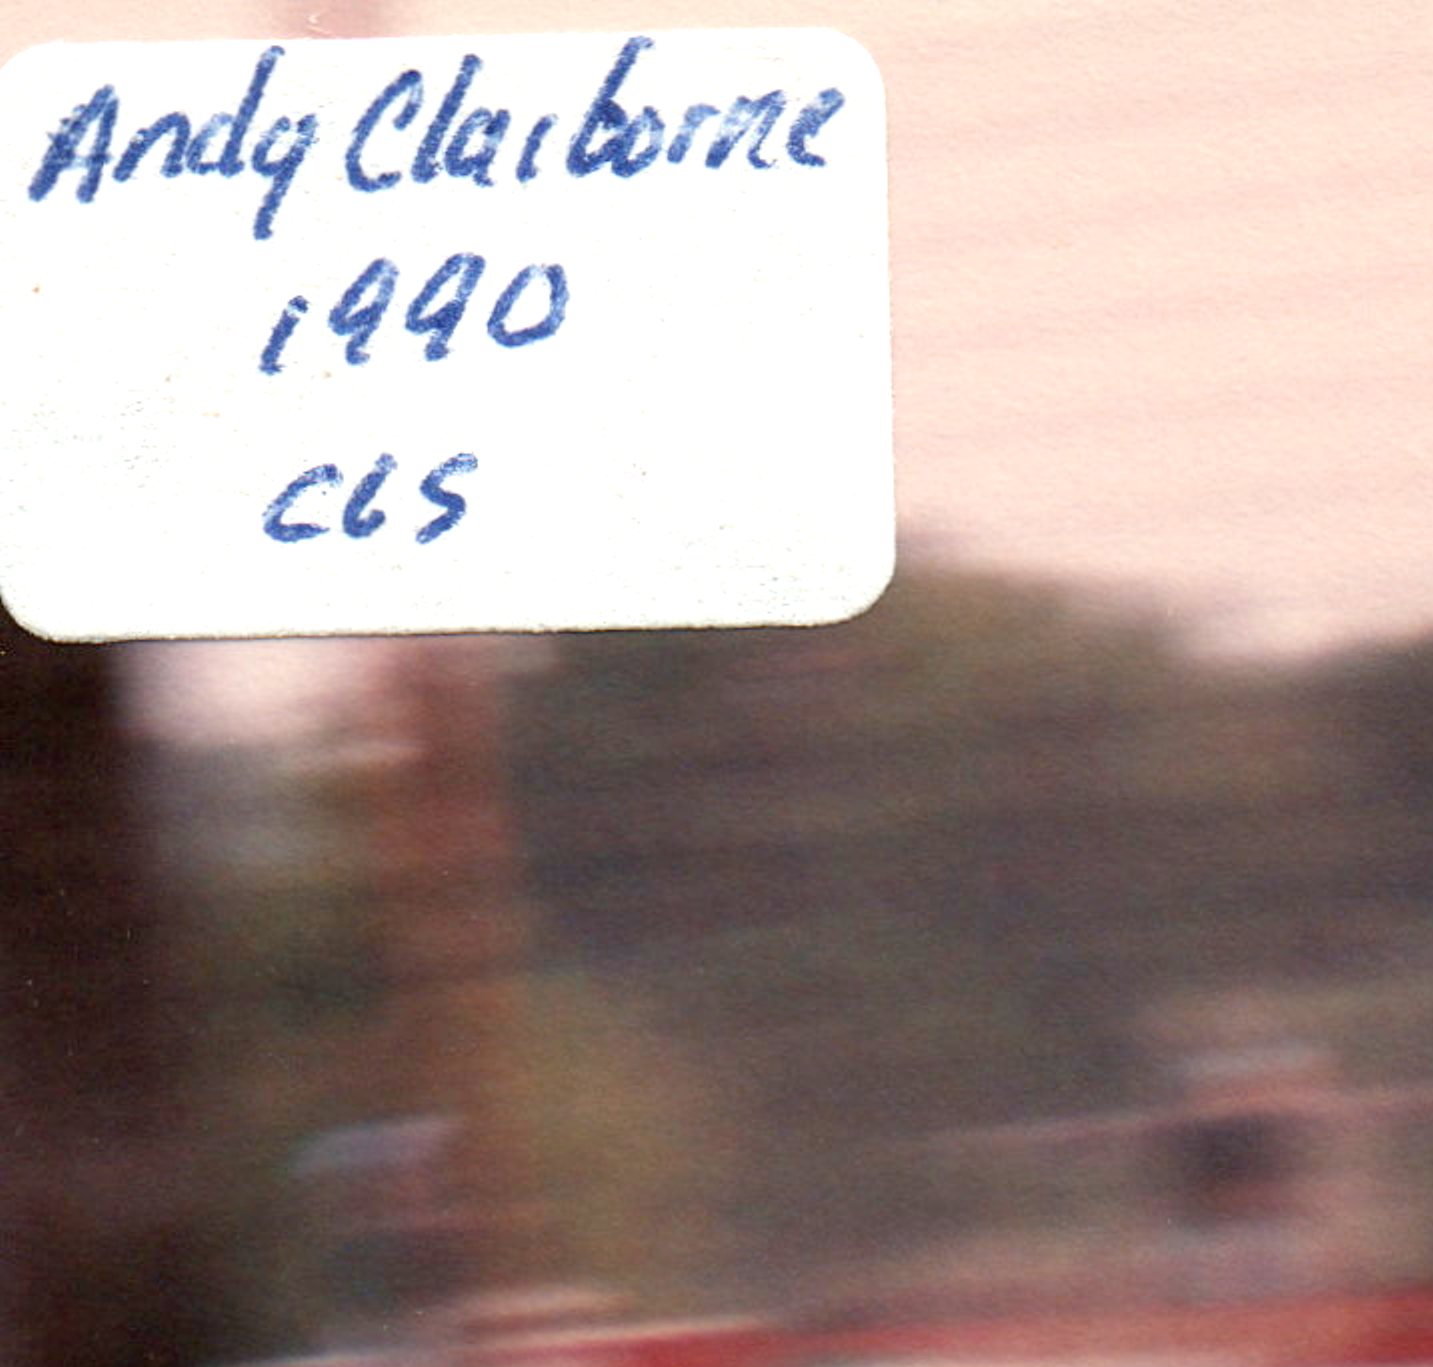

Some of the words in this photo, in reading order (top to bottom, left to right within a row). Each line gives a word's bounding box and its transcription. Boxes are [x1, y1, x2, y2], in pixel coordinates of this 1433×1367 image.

[29, 46, 316, 240] Andy
[346, 37, 844, 193] Claiborne
[256, 252, 569, 376] 1990
